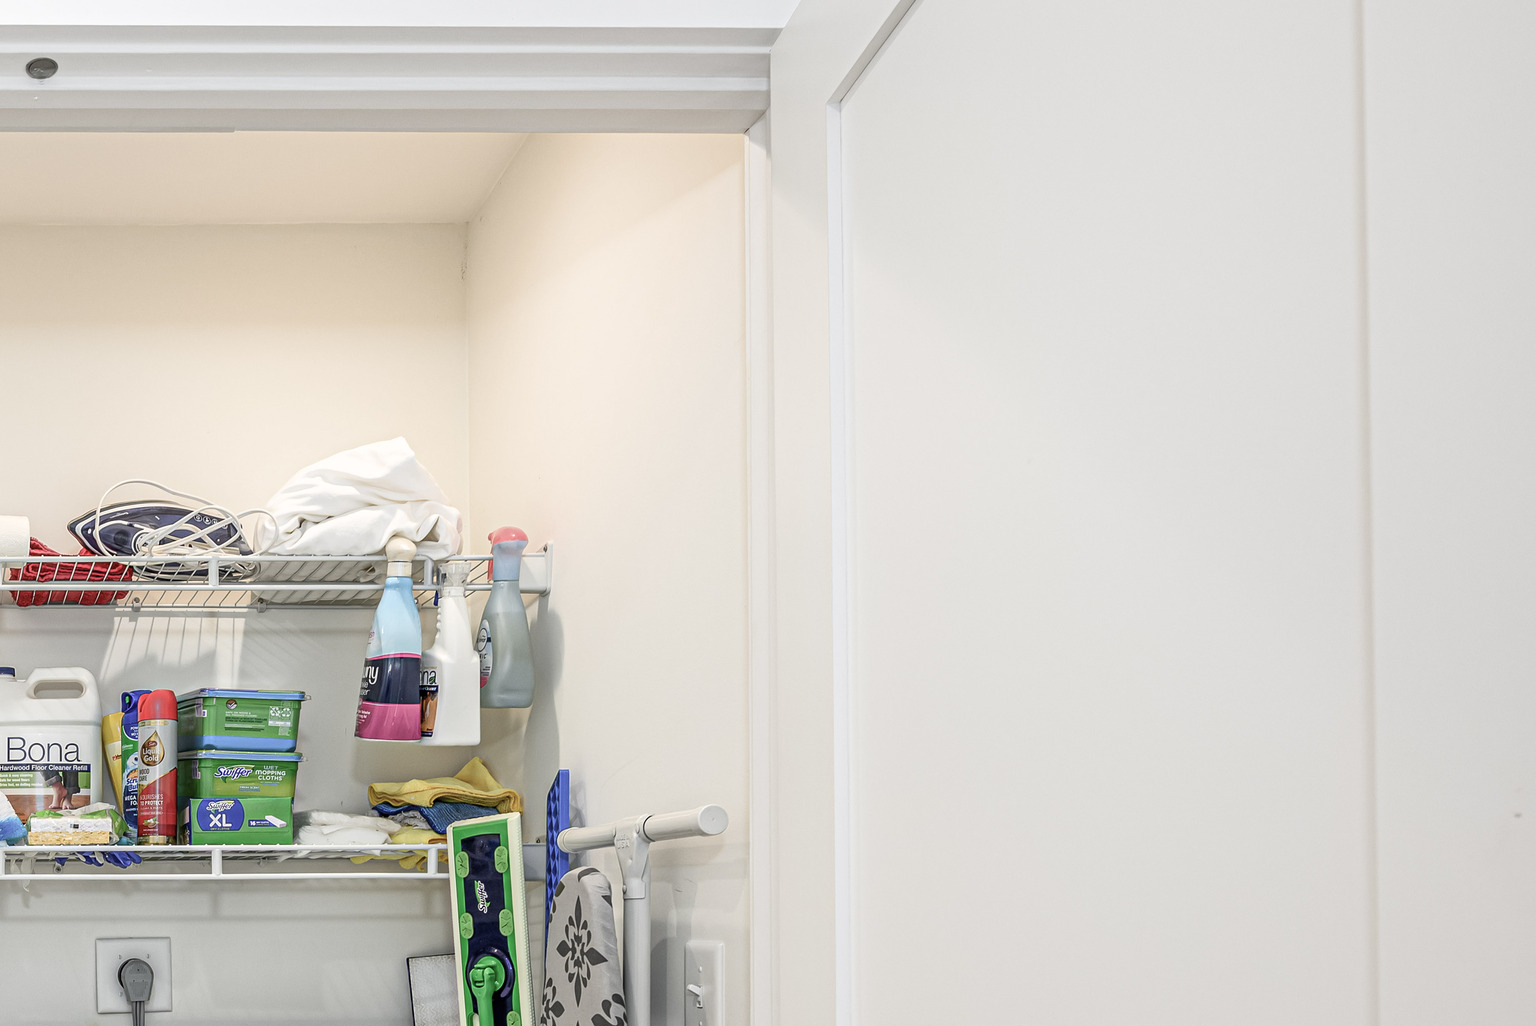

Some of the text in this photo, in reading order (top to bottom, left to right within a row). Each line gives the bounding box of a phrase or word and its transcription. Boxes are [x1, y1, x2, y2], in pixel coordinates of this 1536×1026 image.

[7, 736, 81, 762] Bona
[214, 765, 254, 780] Swiffer
[206, 800, 234, 811] Swiffer
[209, 813, 232, 828] XL
[477, 880, 489, 914] Swiffer
